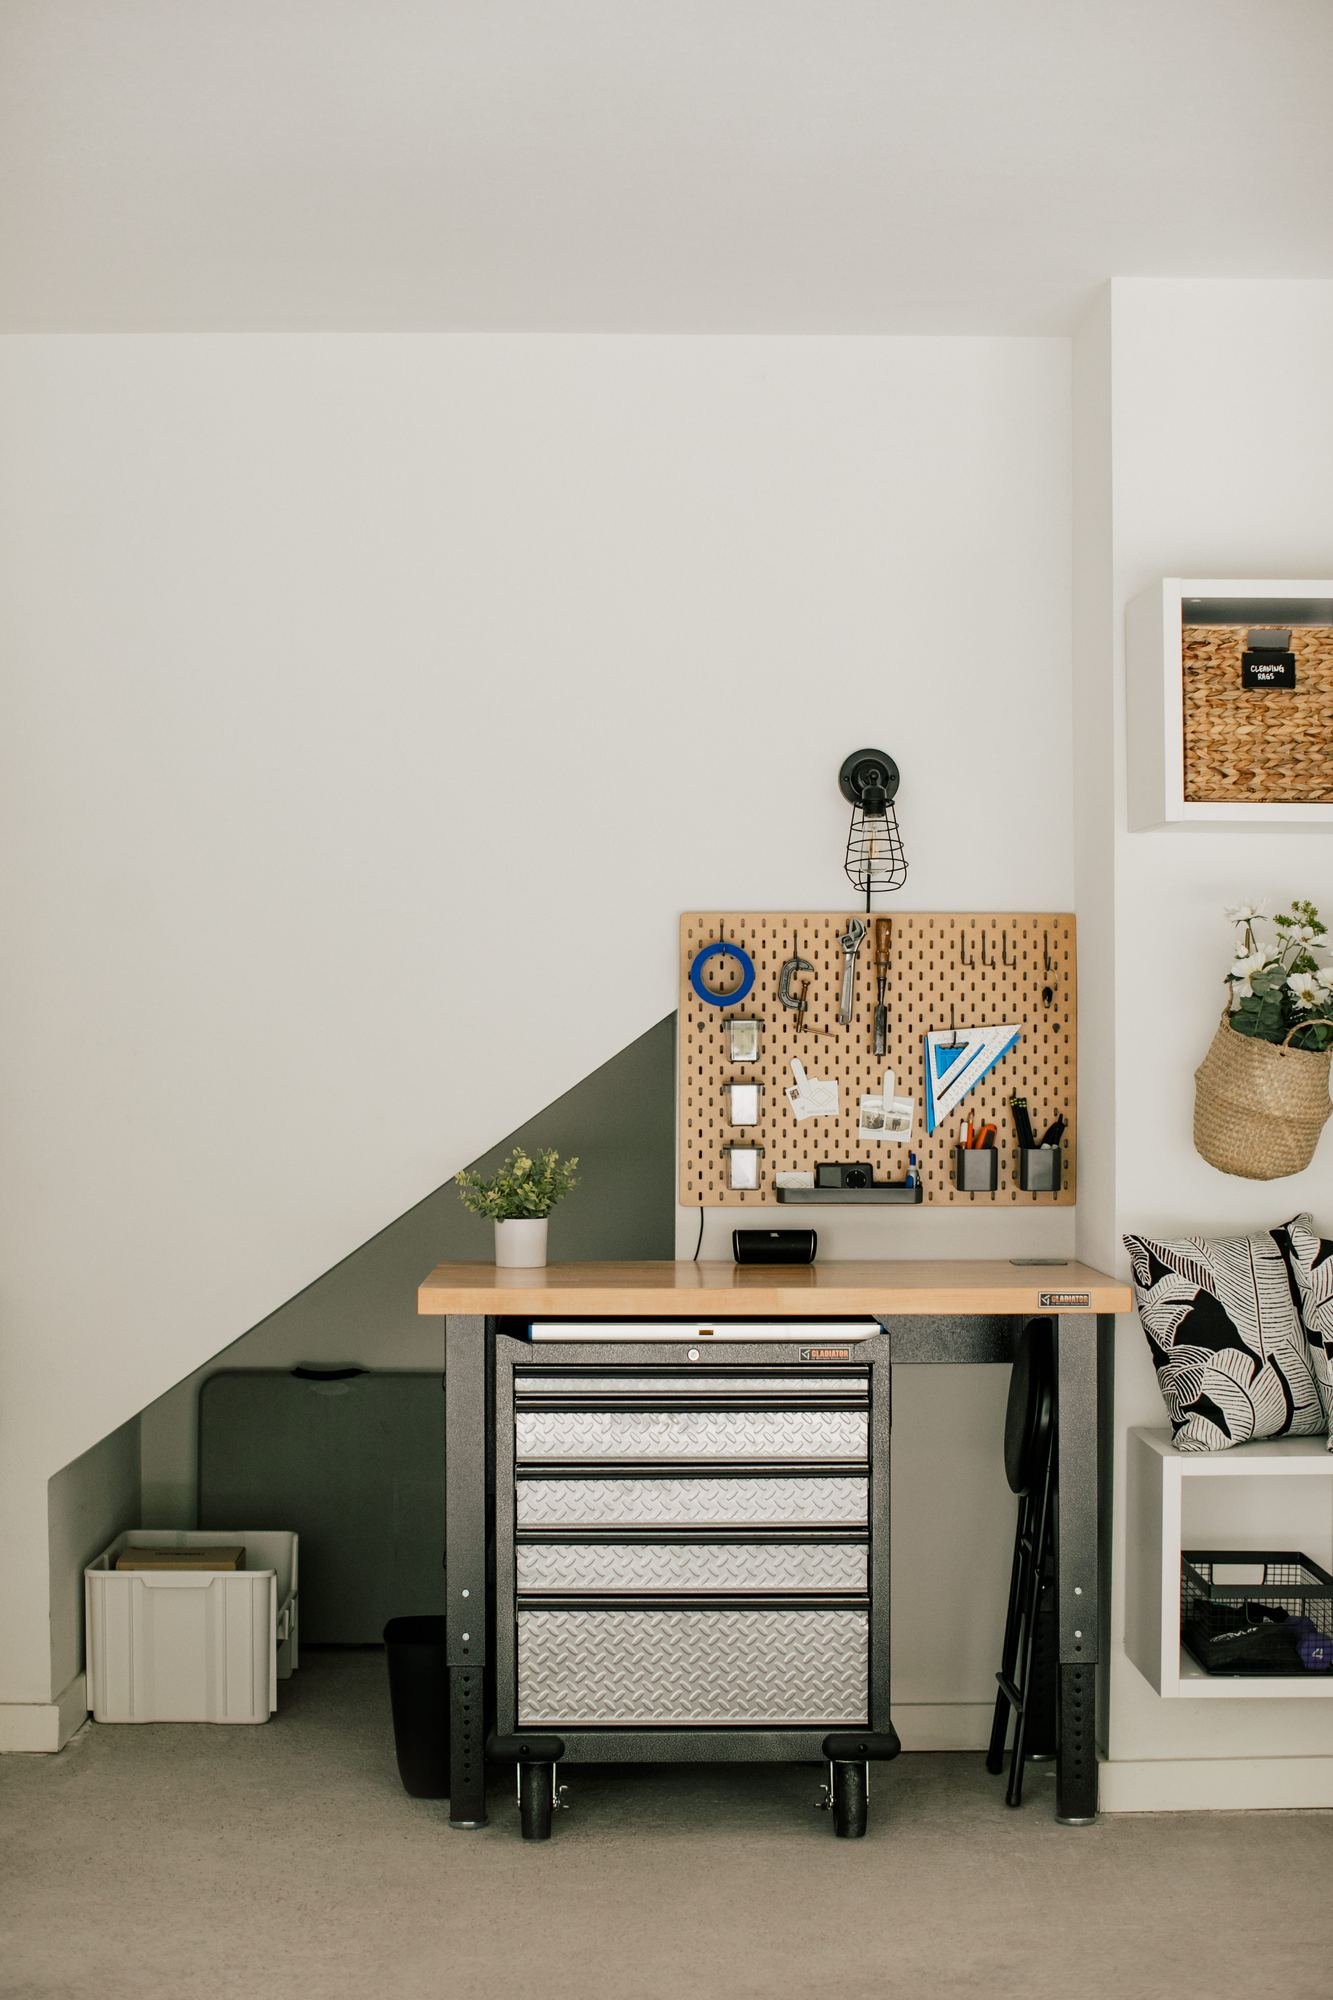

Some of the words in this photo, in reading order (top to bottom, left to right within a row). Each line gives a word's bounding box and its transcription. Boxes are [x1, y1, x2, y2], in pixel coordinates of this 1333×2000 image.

[1250, 664, 1285, 673] CLEANING
[1257, 672, 1275, 680] RAGS
[1051, 1295, 1089, 1303] GLADIATOR
[811, 1349, 849, 1358] GLADIATOR
